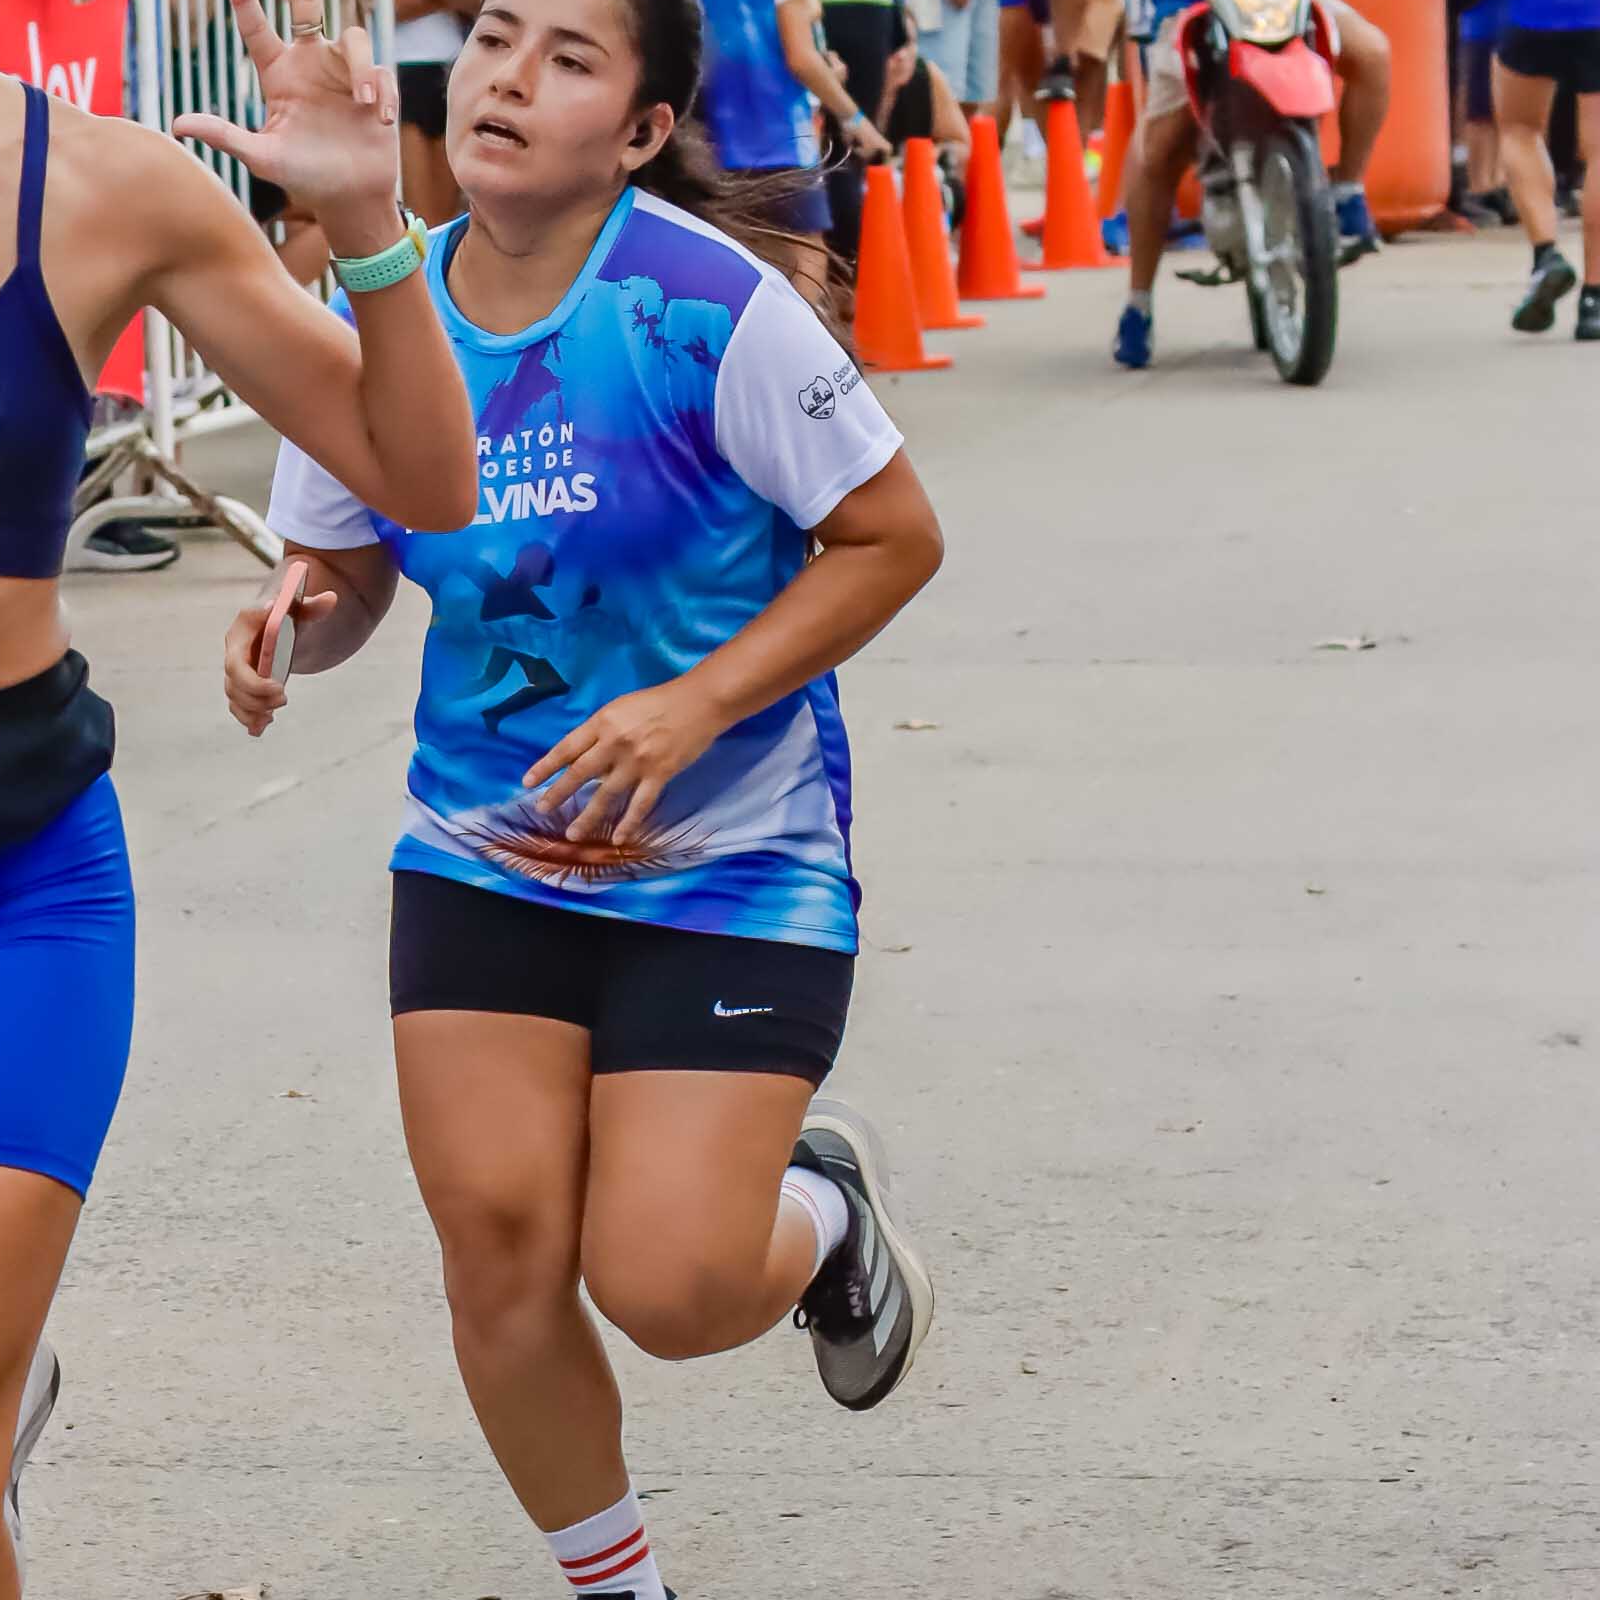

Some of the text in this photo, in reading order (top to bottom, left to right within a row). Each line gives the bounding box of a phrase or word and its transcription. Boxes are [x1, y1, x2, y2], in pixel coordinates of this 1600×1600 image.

[477, 422, 573, 457] RATÓN
[482, 449, 573, 479] OES DE
[405, 473, 598, 535] VINAS
